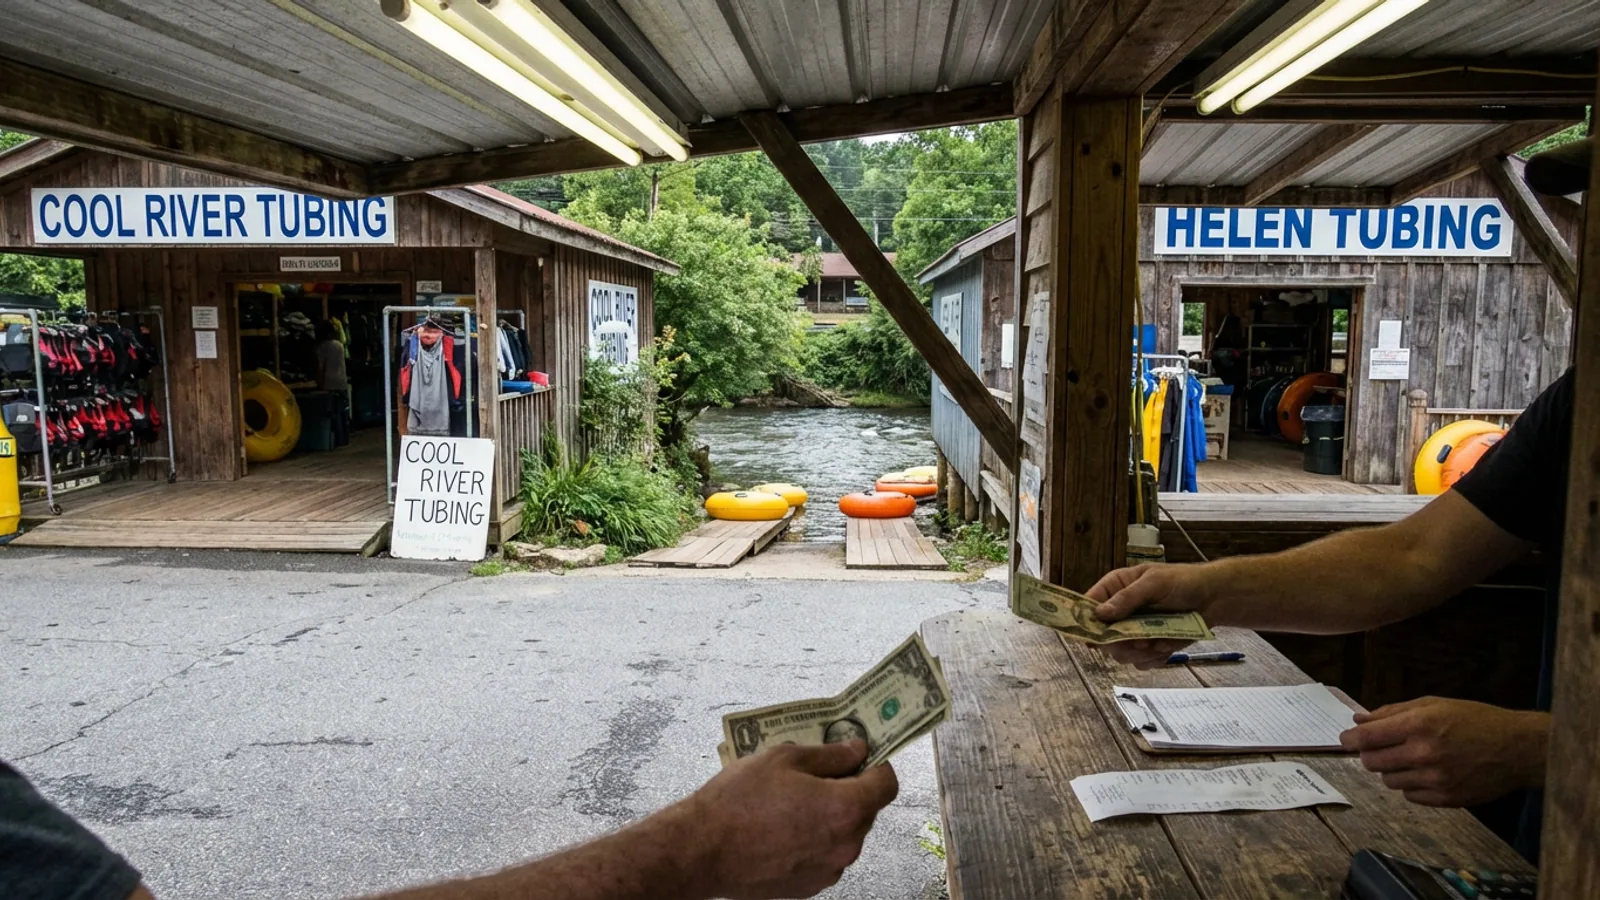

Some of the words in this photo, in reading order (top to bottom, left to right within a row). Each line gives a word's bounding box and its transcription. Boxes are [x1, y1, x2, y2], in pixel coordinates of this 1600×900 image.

[39, 194, 136, 238] COOL
[145, 194, 248, 238] RIVER
[256, 194, 388, 238] TUBING
[1166, 208, 1312, 248] HELEN
[1329, 204, 1501, 250] TUBING
[405, 440, 464, 465] COOL
[420, 468, 485, 495] RIVER
[404, 498, 485, 526] TUBING
